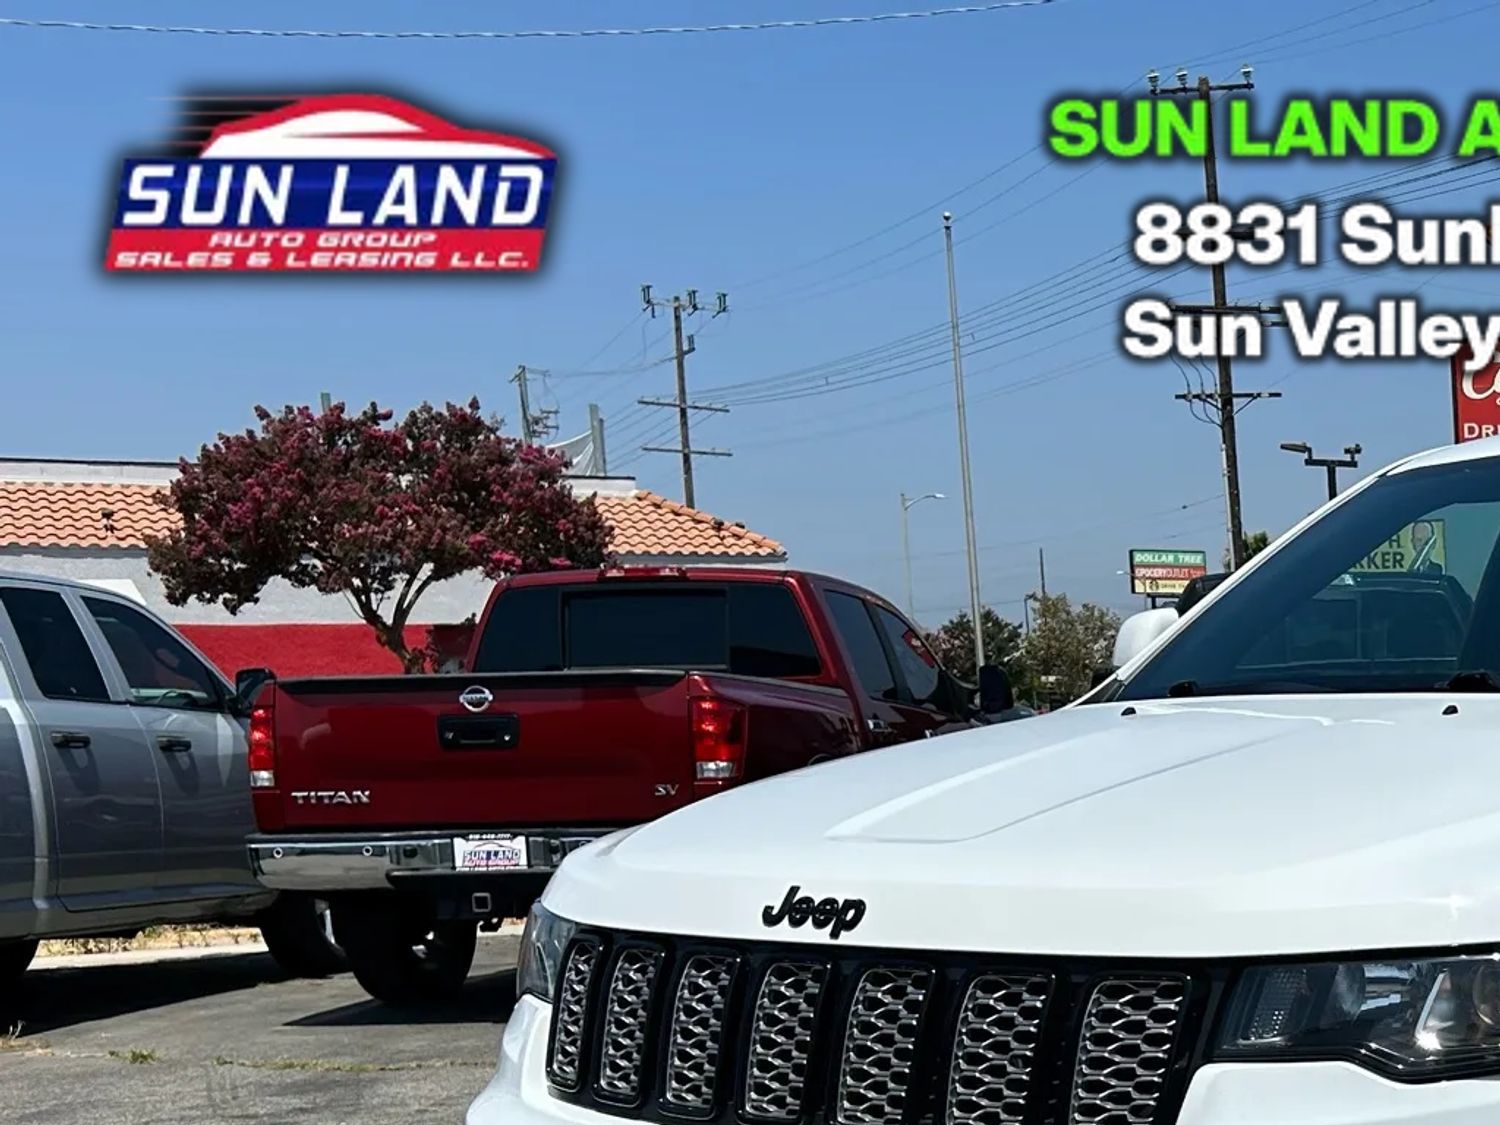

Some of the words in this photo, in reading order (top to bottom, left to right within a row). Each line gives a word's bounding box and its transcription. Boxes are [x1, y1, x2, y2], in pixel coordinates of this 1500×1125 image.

[1135, 553, 1175, 564] DOLLAR
[1178, 554, 1204, 564] TREE
[654, 783, 680, 797] SV
[290, 790, 371, 805] TITAN
[762, 885, 867, 940] Jeep
